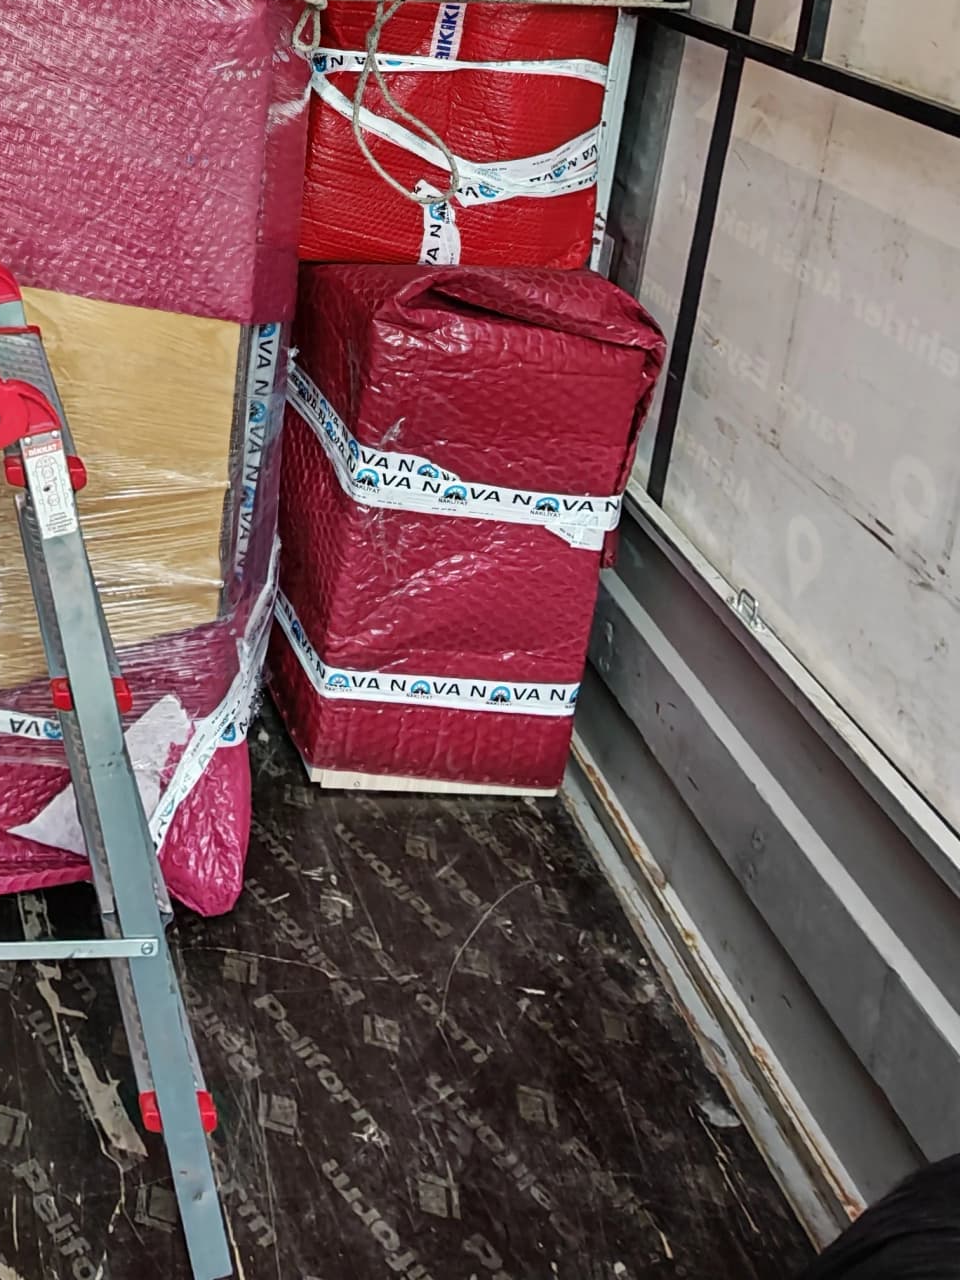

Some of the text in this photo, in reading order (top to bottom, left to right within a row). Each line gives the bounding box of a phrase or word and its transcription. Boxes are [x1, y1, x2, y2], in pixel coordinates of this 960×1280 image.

[422, 481, 500, 502] NOVA
[512, 494, 593, 512] NOVA
[390, 680, 460, 696] NOVA
[470, 686, 540, 701] NOVA
[13, 1157, 96, 1279] Pelifo
